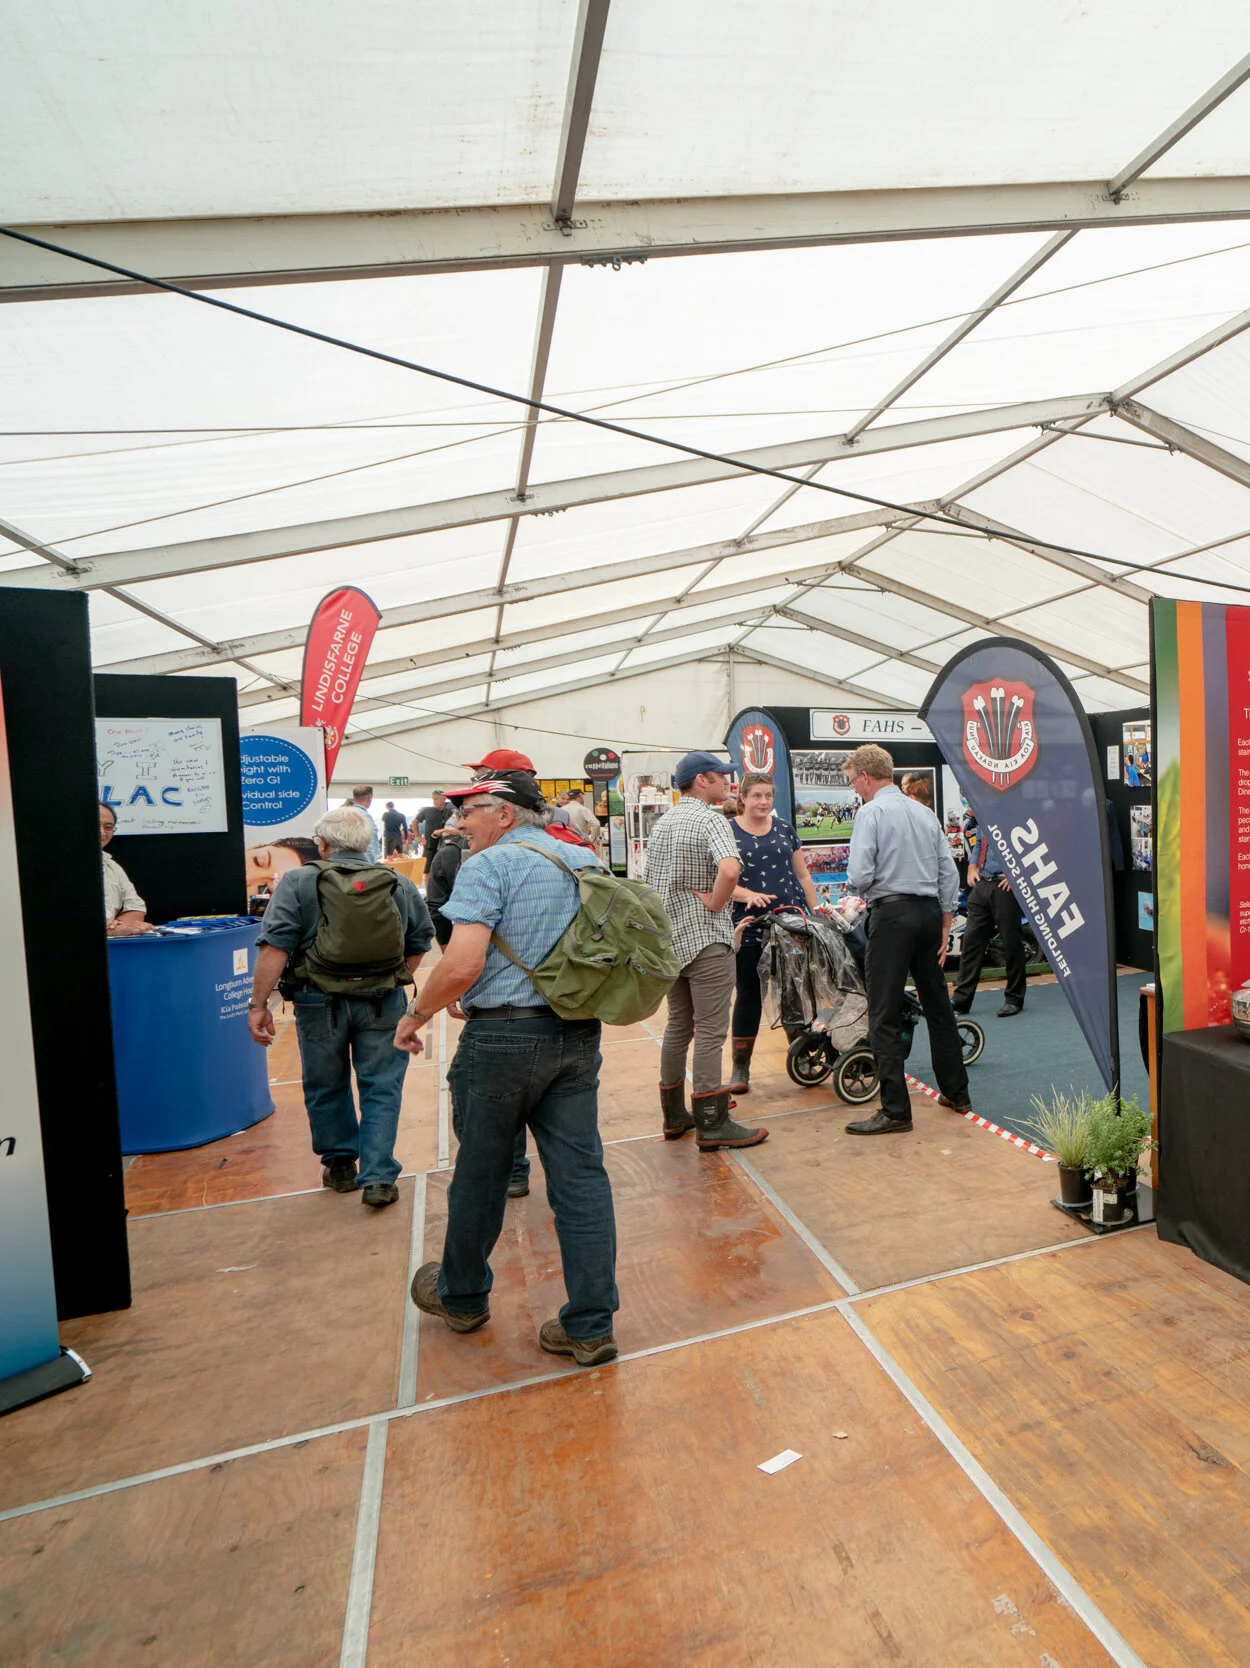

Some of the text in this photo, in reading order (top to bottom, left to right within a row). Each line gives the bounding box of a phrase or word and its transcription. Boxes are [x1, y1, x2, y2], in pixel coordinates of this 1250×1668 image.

[311, 608, 353, 712] LINDISFARNE
[331, 630, 363, 704] COLLEGE
[862, 719, 905, 733] FAHS
[240, 754, 289, 764] djustable
[240, 765, 290, 775] ight with
[241, 776, 264, 784] Zero
[390, 777, 409, 786] Exit
[242, 790, 300, 798] vidual side
[242, 801, 282, 809] Control
[224, 990, 243, 1000] College
